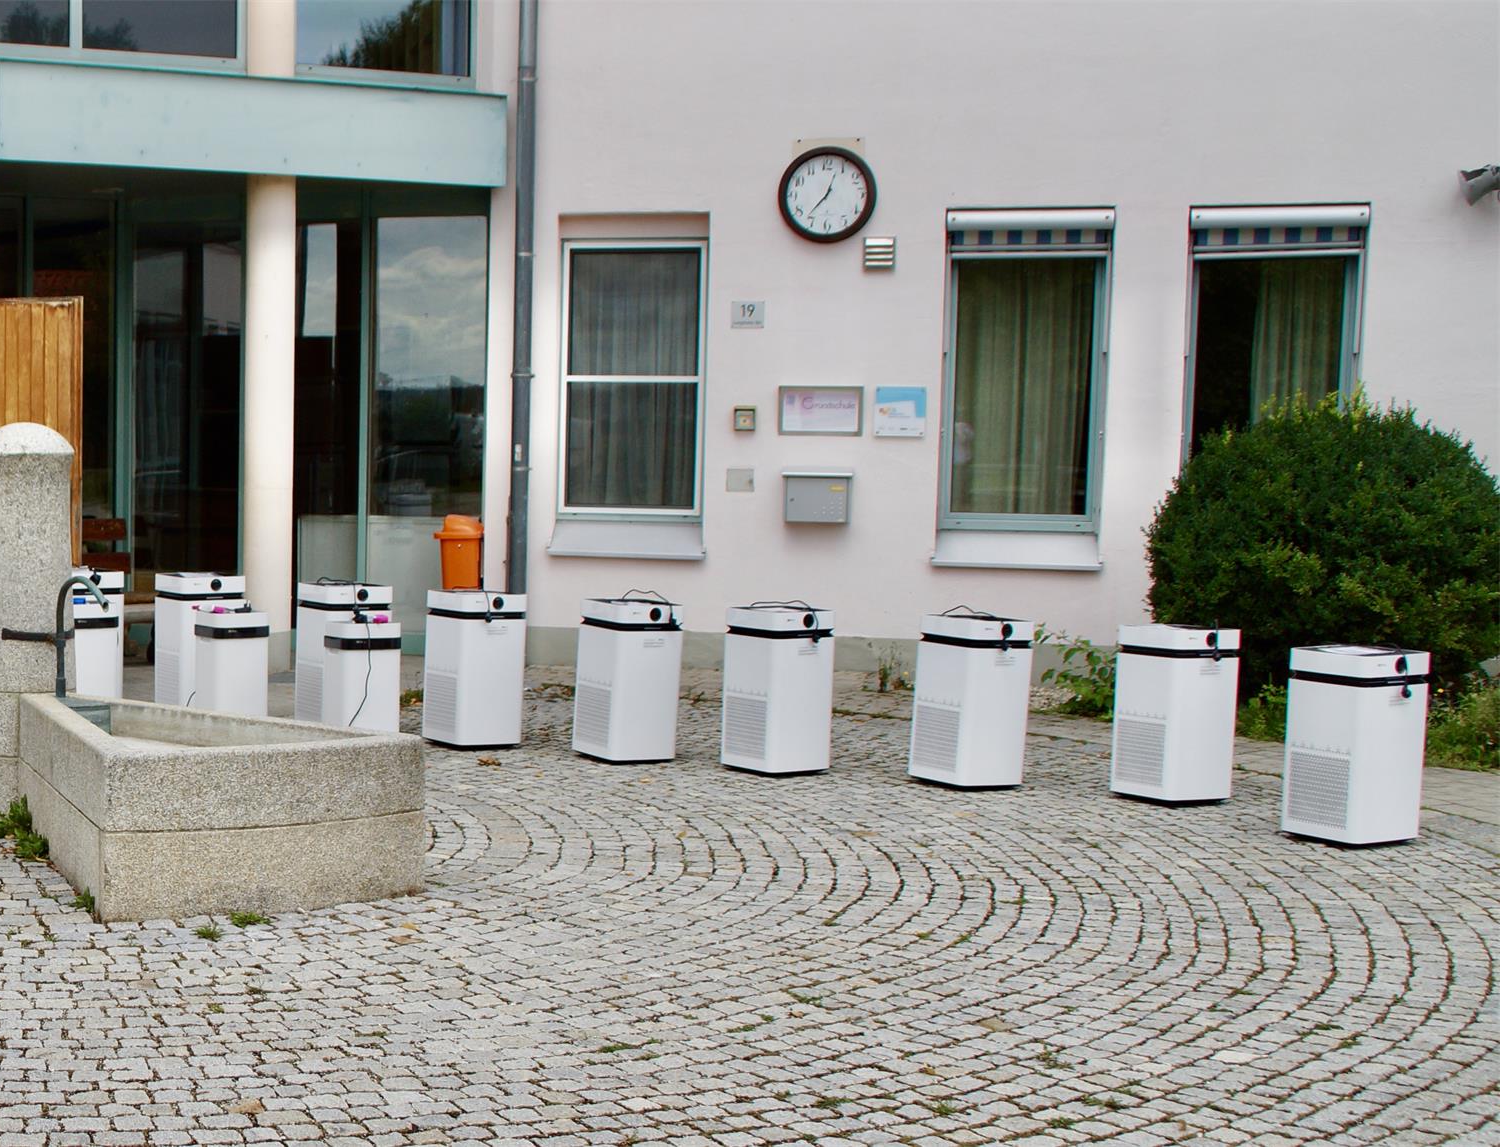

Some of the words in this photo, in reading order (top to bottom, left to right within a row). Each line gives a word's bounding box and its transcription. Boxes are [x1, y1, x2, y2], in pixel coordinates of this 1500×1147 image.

[807, 163, 815, 176] 11
[822, 158, 833, 171] 12
[841, 161, 845, 174] 1
[795, 175, 805, 187] 10
[851, 171, 860, 185] 2
[788, 190, 798, 202] 9
[795, 206, 804, 217] 8
[807, 216, 815, 228] 7
[823, 218, 832, 231] 6
[840, 214, 848, 227] 5
[740, 304, 756, 318] 19
